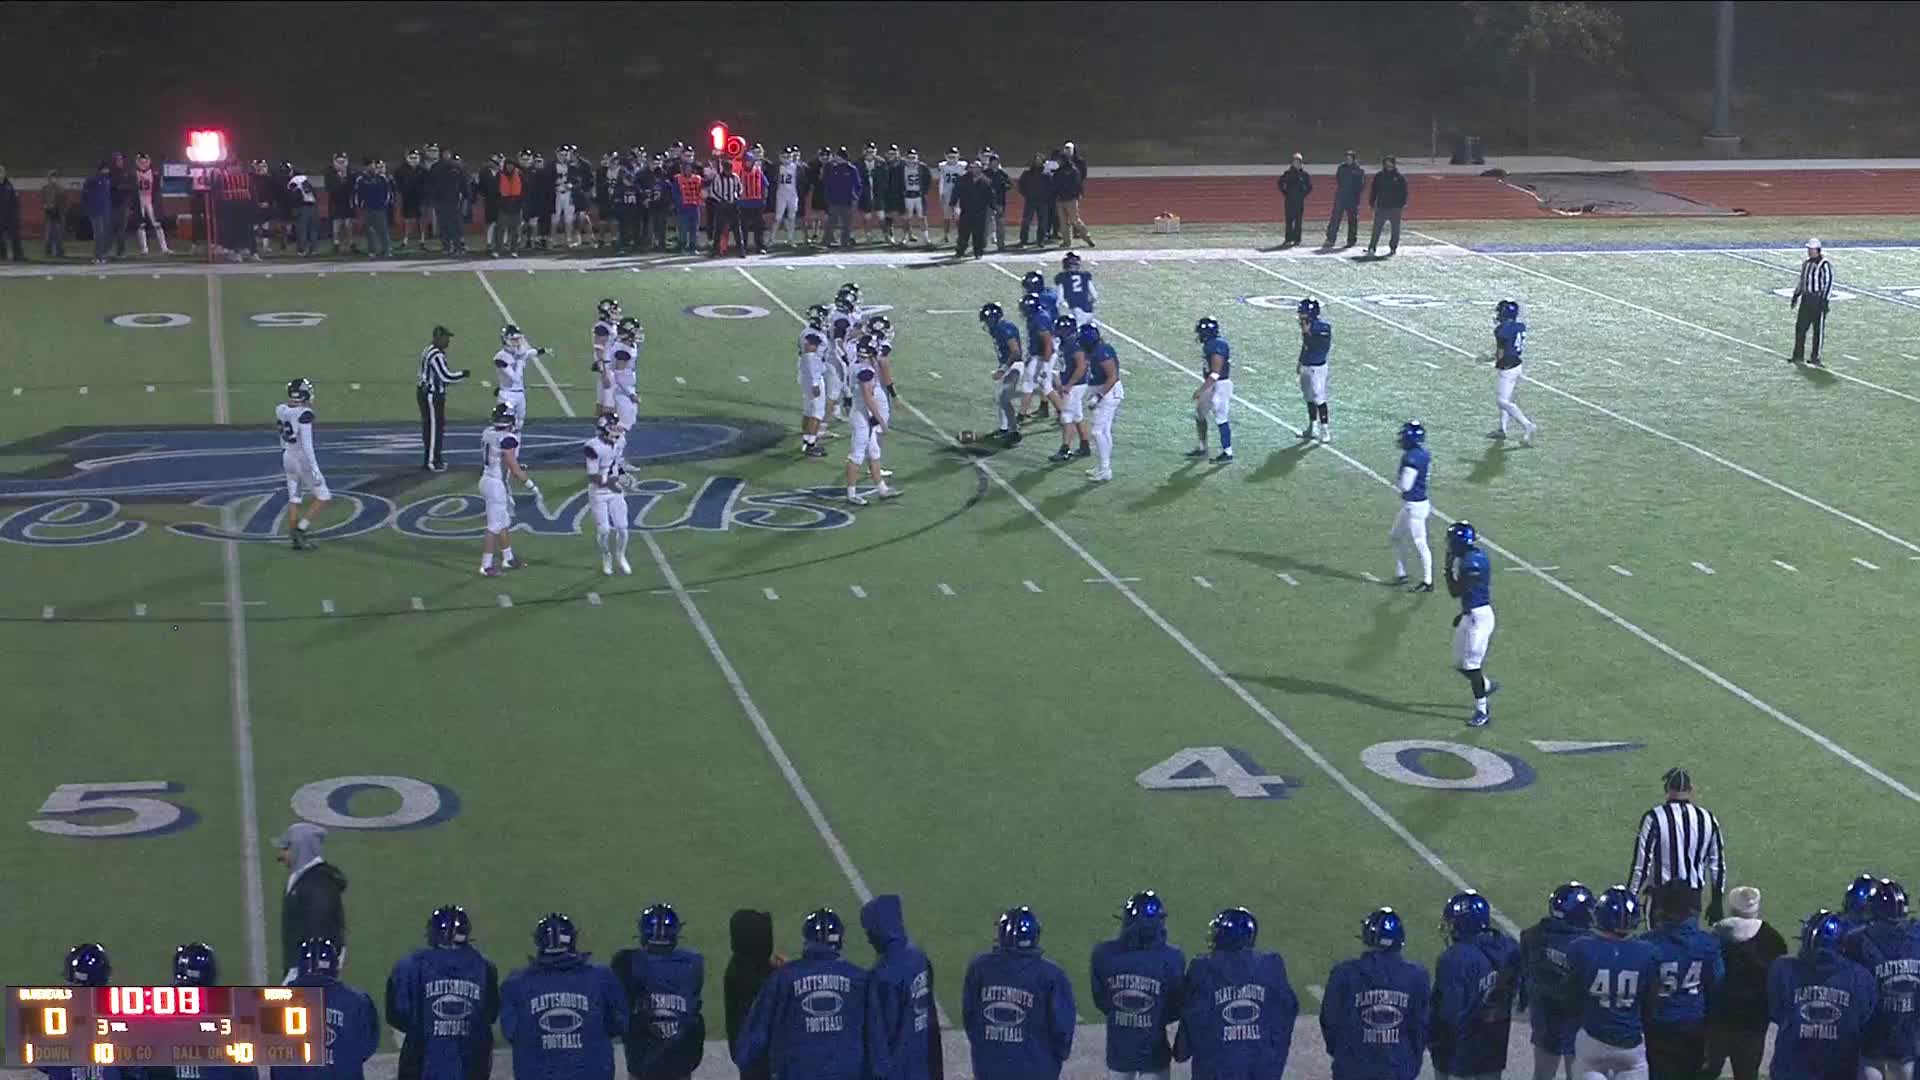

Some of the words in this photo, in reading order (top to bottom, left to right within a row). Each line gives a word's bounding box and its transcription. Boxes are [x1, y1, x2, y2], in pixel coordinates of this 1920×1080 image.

[1071, 274, 1083, 292] 2
[165, 475, 878, 543] Devils
[425, 979, 481, 1000] PLATTSMOUTH
[793, 974, 850, 996] PLATTSMOUTH
[1589, 968, 1639, 1008] 40
[530, 992, 588, 1014] PLATTSMOUTH
[981, 985, 1034, 1008] LATTSMOUTH
[1354, 989, 1409, 1008] PLATTSMOUTH
[433, 1020, 470, 1036] FOOTBALL
[805, 1015, 843, 1032] FOOTBALL
[1223, 1024, 1261, 1041] FOOTBALL
[1800, 1023, 1838, 1040] FOOTBALL
[541, 1033, 582, 1049] FOOTBALL
[985, 1024, 1023, 1042] FOOTBALL
[1362, 1028, 1400, 1043] FOOTBALL
